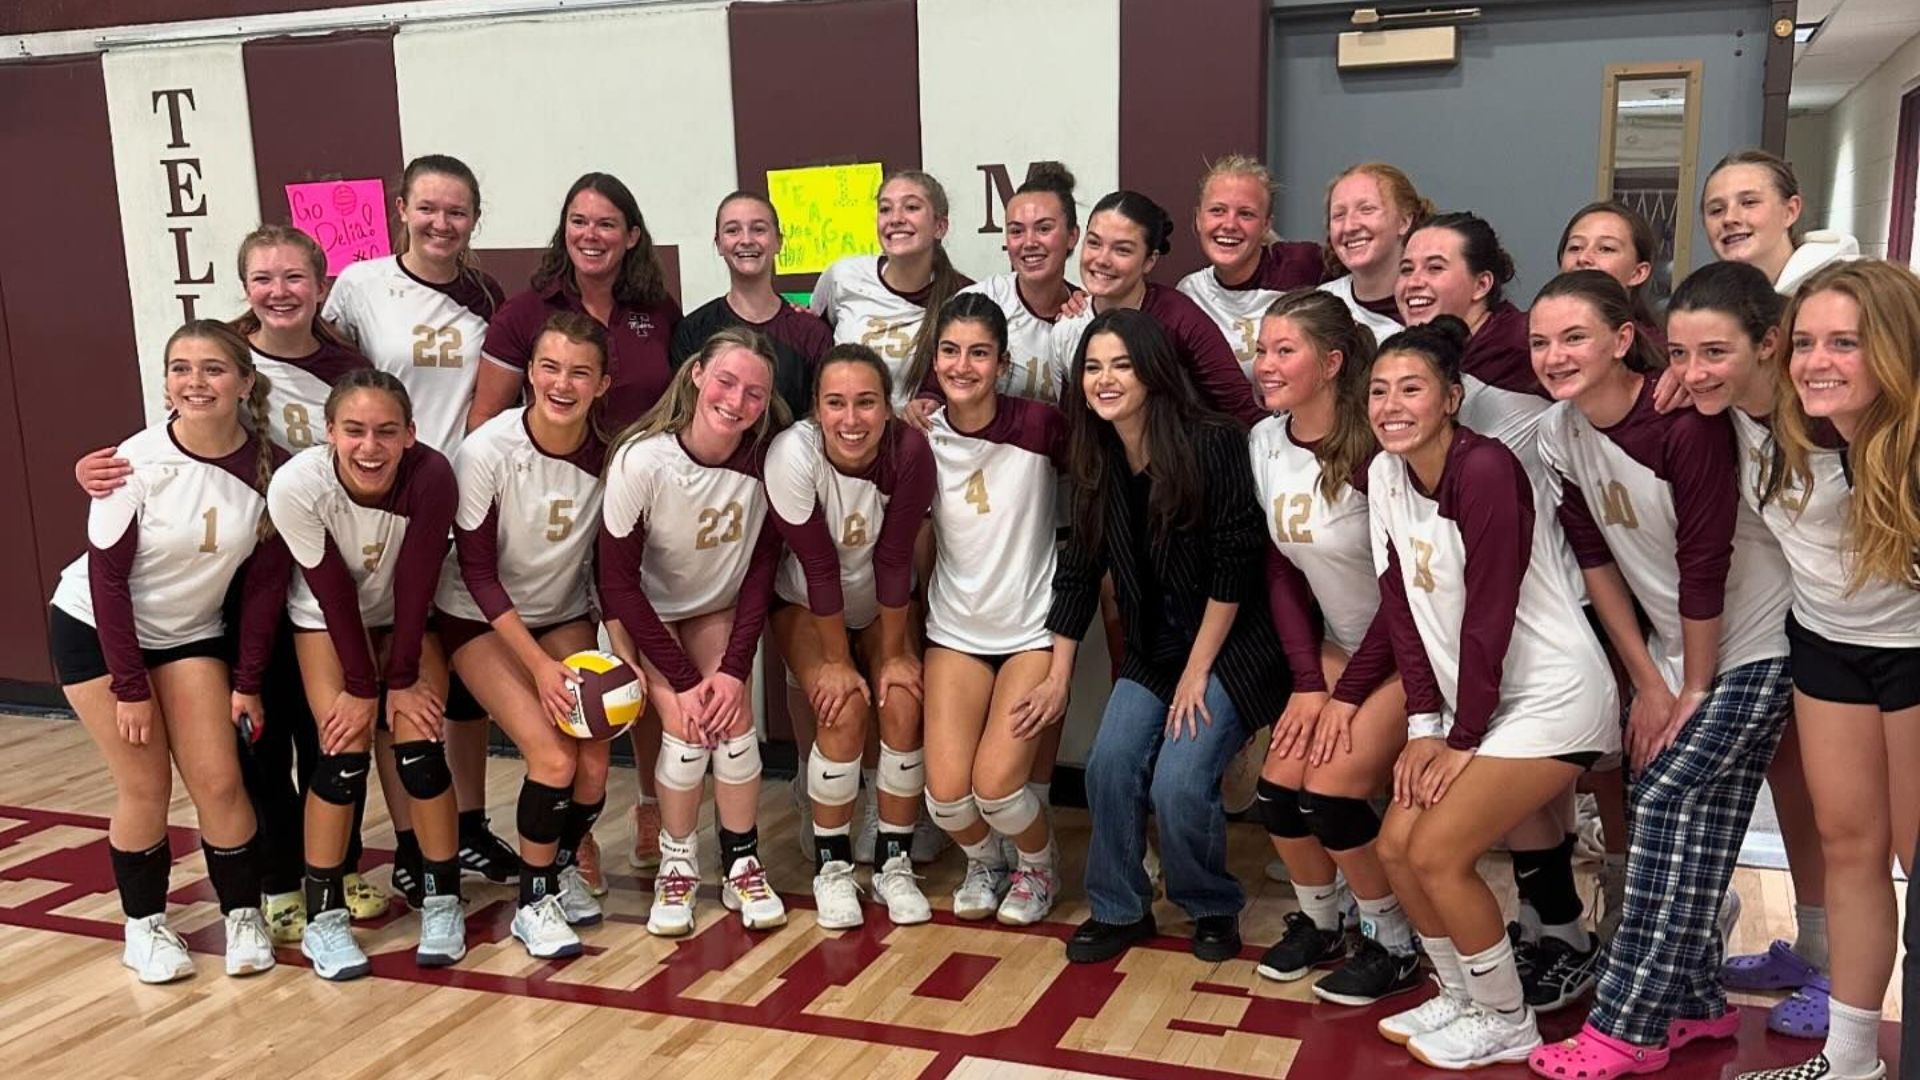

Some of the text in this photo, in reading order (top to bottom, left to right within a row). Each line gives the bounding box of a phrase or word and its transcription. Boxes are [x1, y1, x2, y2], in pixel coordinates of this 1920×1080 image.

[292, 190, 323, 221] Go
[314, 203, 376, 252] Delia!
[412, 324, 464, 368] 22
[283, 402, 313, 449] 8
[964, 468, 990, 515] 4
[1597, 478, 1639, 529] 10
[199, 506, 219, 554] 1
[546, 499, 575, 542] 5
[696, 501, 743, 550] 23
[842, 511, 866, 546] 6
[1273, 492, 1313, 543] 12
